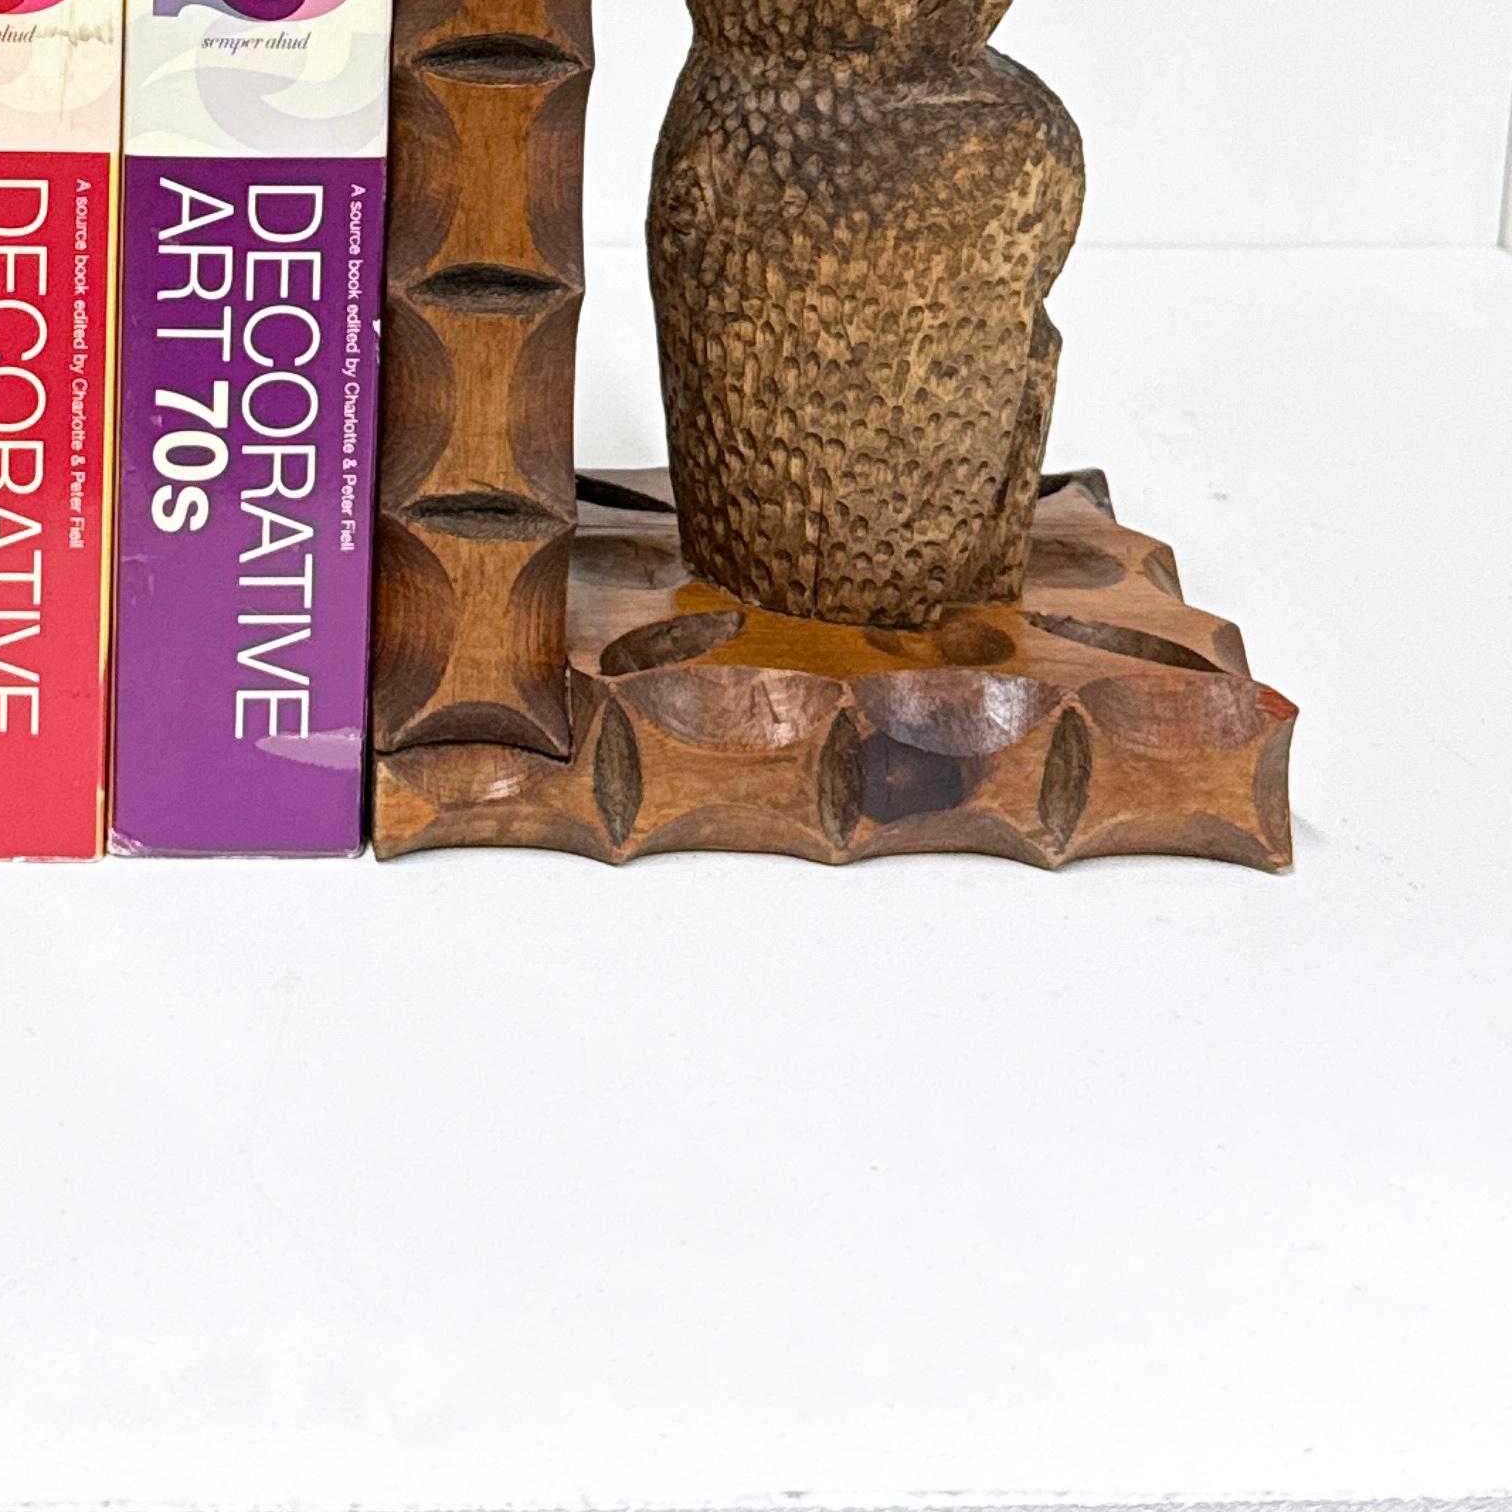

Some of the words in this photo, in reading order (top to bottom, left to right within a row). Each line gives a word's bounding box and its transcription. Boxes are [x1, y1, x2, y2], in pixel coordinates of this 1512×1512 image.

[201, 37, 264, 56] semper
[265, 31, 312, 49] aliud
[77, 179, 91, 191] A
[352, 184, 365, 197] A
[75, 197, 87, 250] source
[350, 201, 361, 255] source
[75, 255, 89, 294] book
[157, 178, 234, 361] ART
[348, 260, 362, 299] book
[74, 300, 88, 349] edited
[346, 305, 361, 352] edited
[70, 354, 87, 374] by
[342, 358, 360, 377] by
[72, 379, 87, 450] Charlotte
[343, 383, 359, 453] Charlotte
[71, 455, 85, 466] &
[152, 381, 228, 532] 70s
[235, 185, 324, 739] DECORATIVE
[343, 459, 357, 469] &
[70, 472, 85, 512] Peter
[341, 475, 356, 516] Peter
[69, 517, 84, 548] Fiell
[341, 520, 355, 550] Fiell
